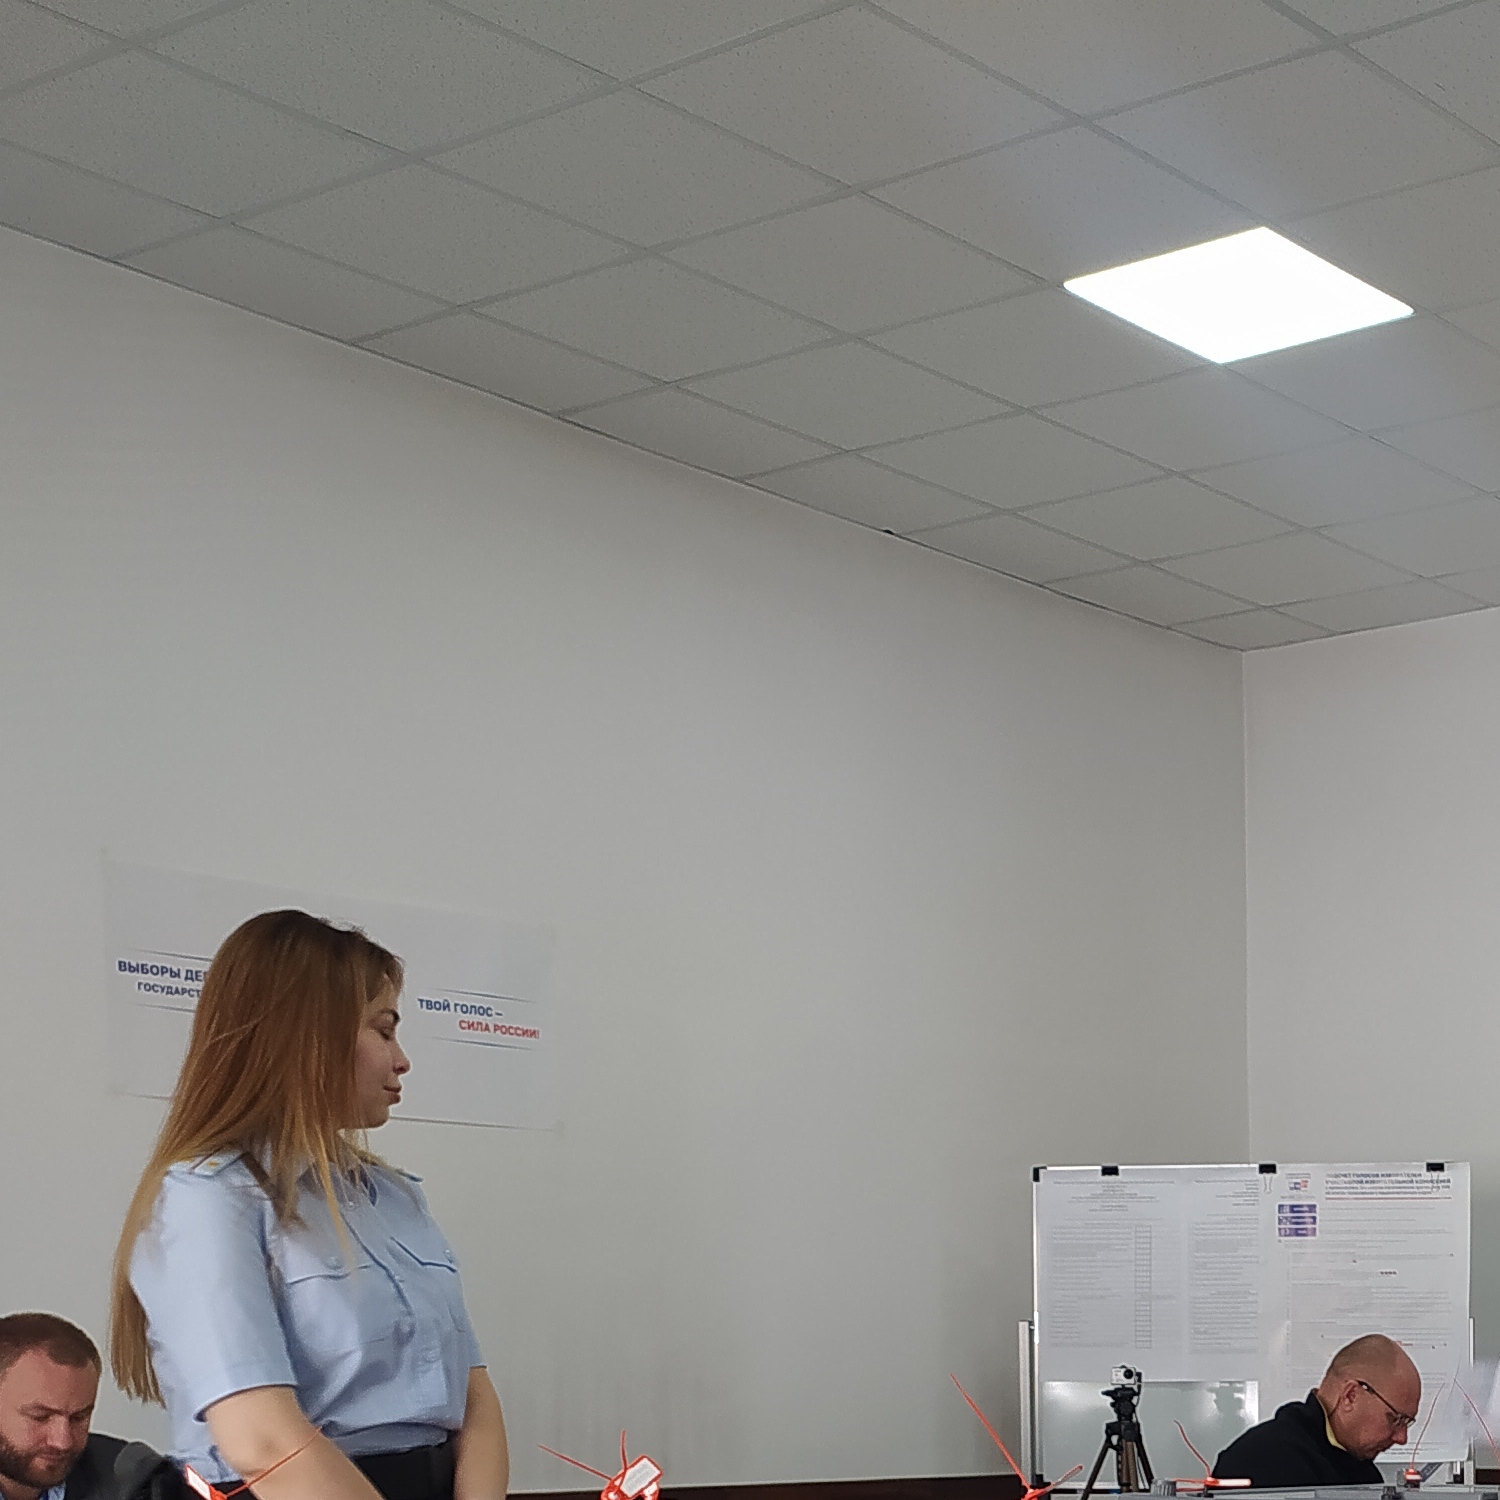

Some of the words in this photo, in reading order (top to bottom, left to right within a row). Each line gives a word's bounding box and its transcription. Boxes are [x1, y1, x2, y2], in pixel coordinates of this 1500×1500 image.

[118, 960, 180, 979] ВЫБОРЫ
[417, 998, 451, 1013] ТВОЙ
[453, 1003, 494, 1017] ГОЛОС
[458, 1019, 491, 1033] СИЛА
[493, 1023, 540, 1039] РОССИИ!
